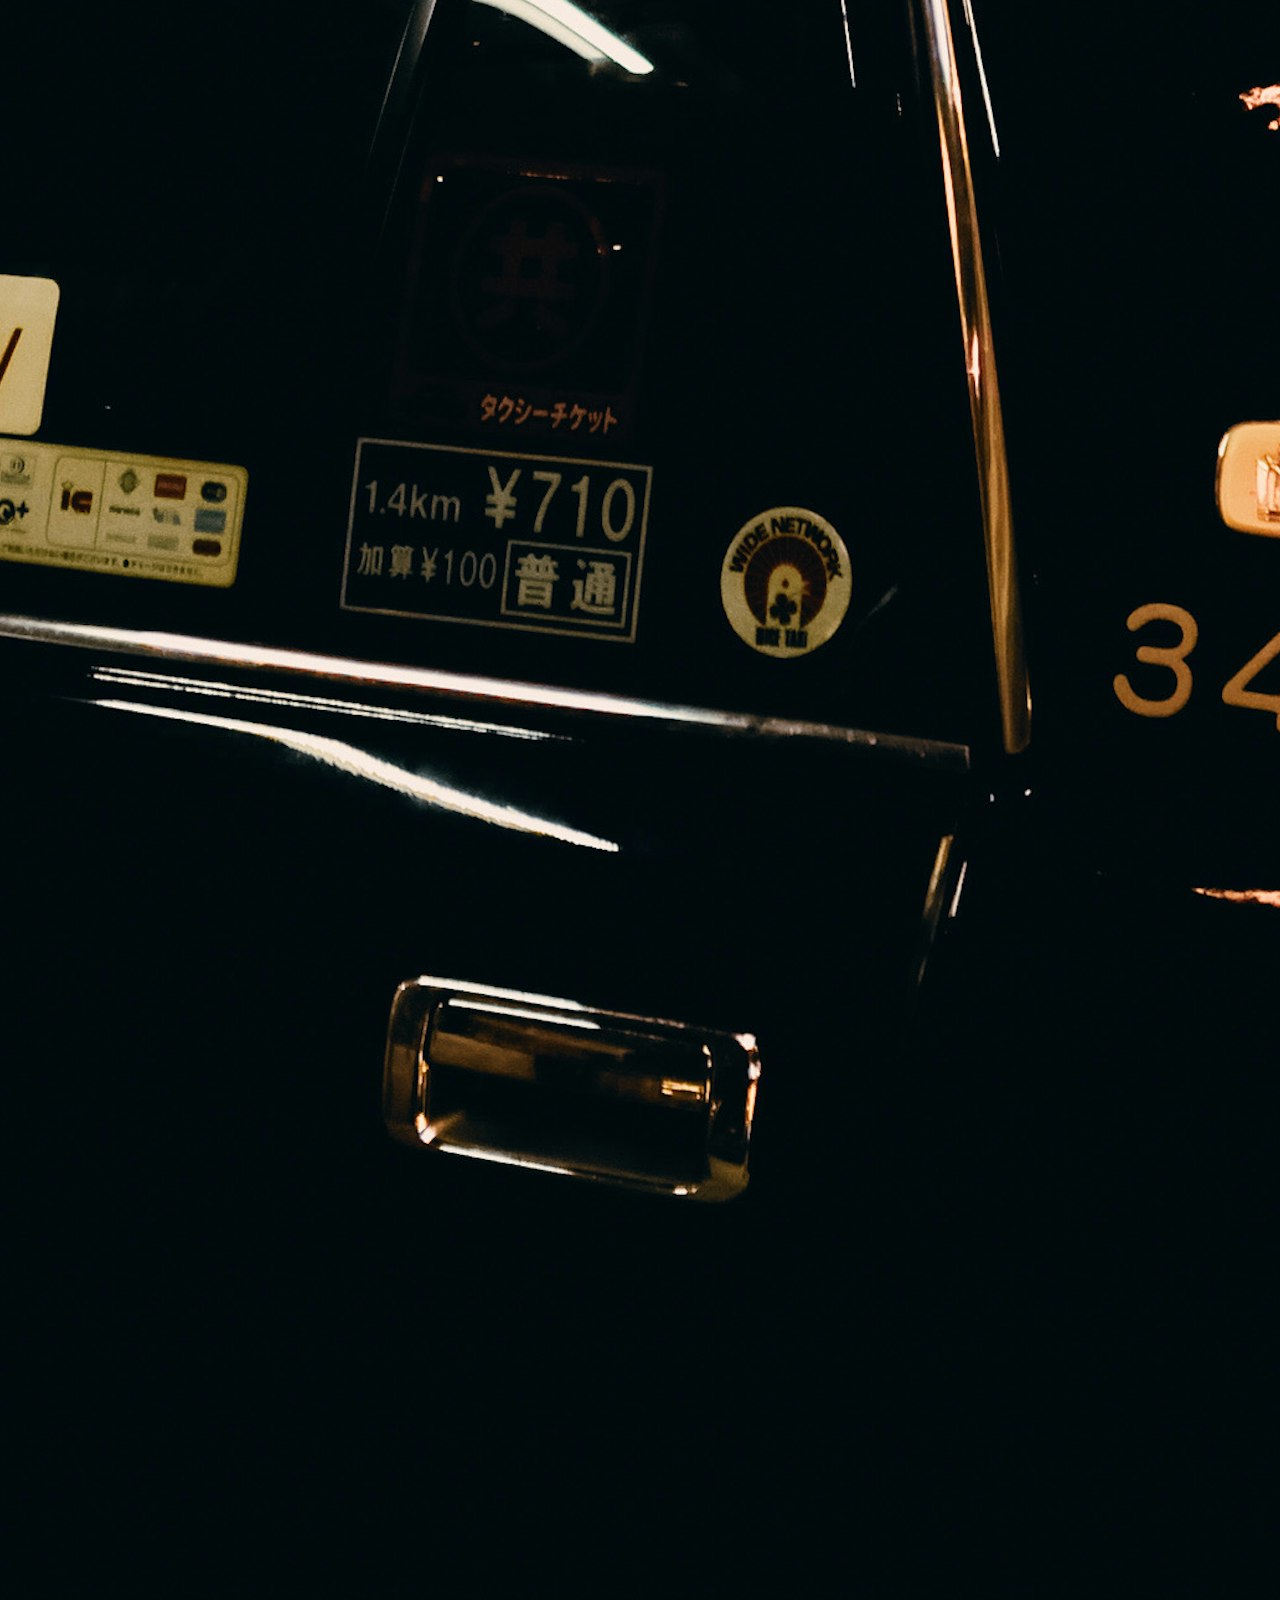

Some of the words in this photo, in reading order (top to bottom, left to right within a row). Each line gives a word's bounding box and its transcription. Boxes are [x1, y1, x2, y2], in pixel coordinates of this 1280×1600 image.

[480, 393, 618, 434] タクシーチケット
[365, 480, 461, 522] 1.4km
[484, 466, 635, 543] ¥710
[730, 523, 770, 573] WIDE
[771, 516, 842, 581] NETWORK
[515, 553, 616, 616] 普通
